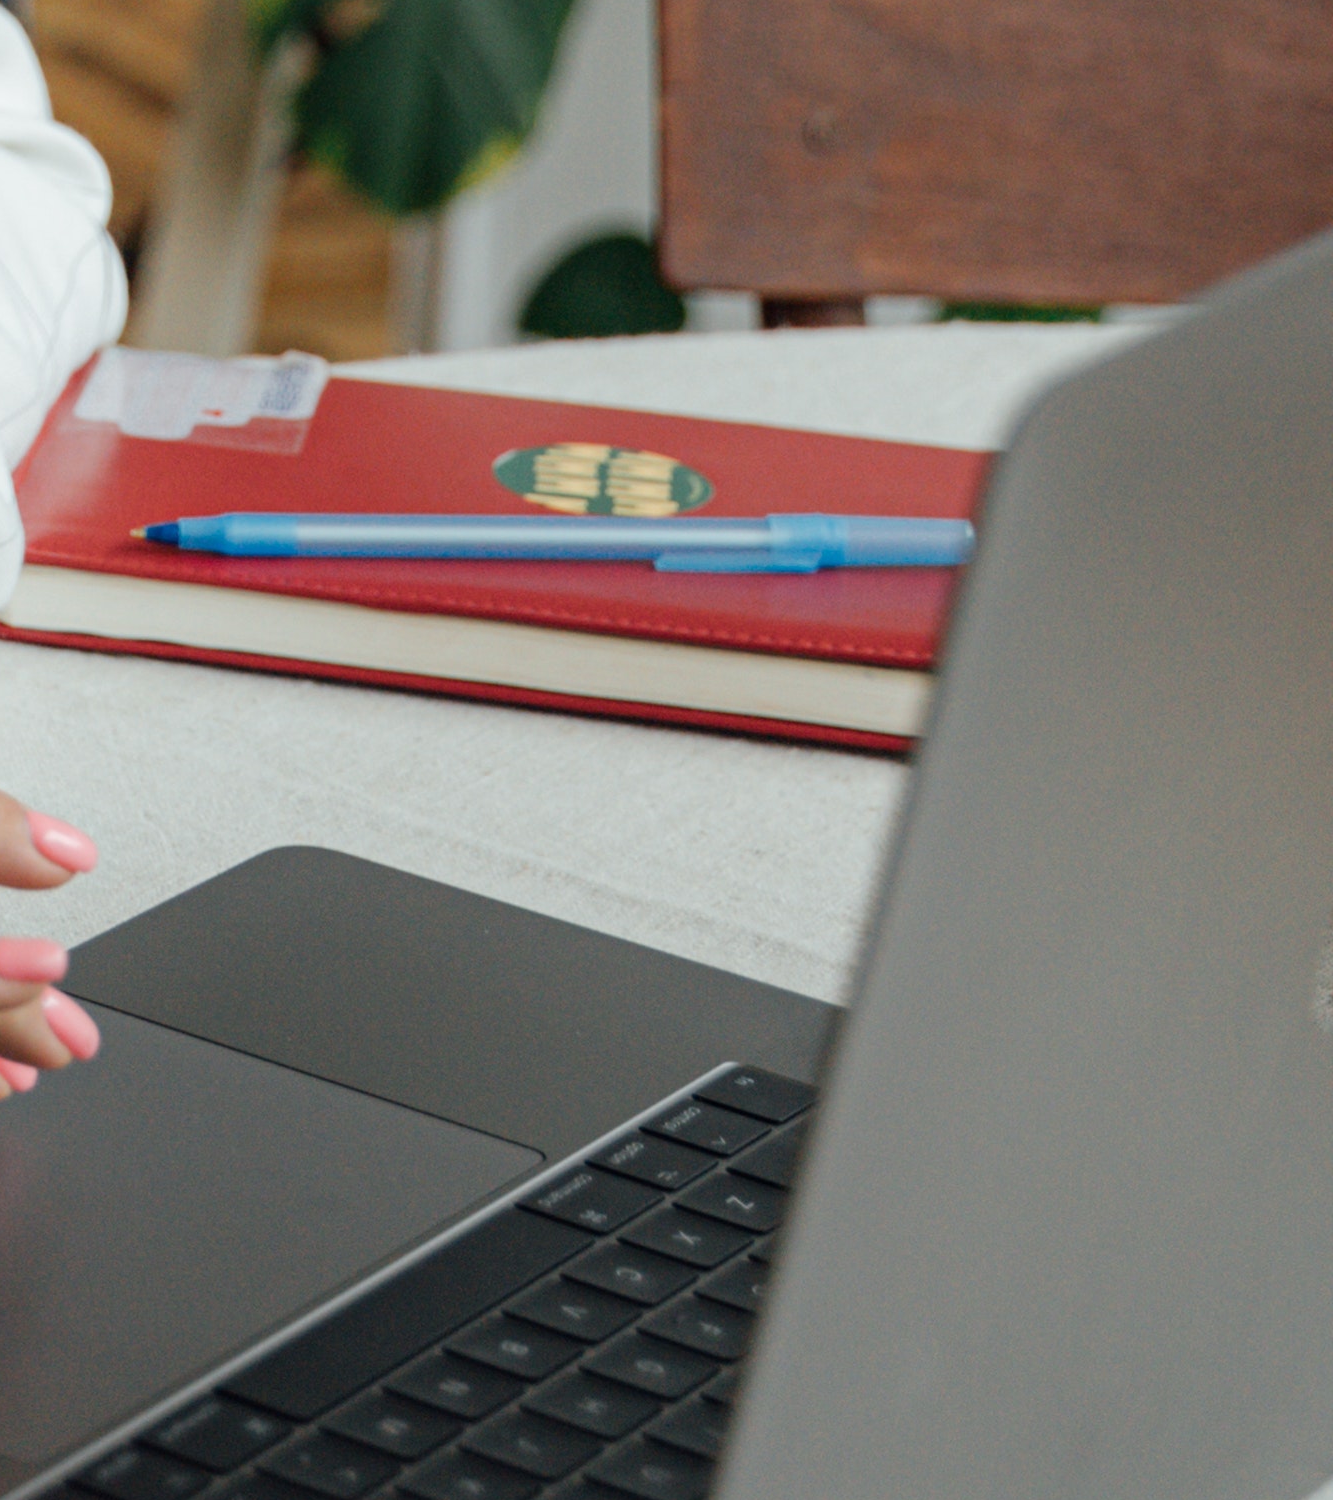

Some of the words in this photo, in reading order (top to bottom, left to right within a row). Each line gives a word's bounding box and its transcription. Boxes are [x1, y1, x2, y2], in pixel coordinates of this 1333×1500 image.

[662, 1106, 701, 1132] control
[726, 1195, 755, 1211] Z
[672, 1230, 702, 1246] X
[616, 1268, 643, 1282] C
